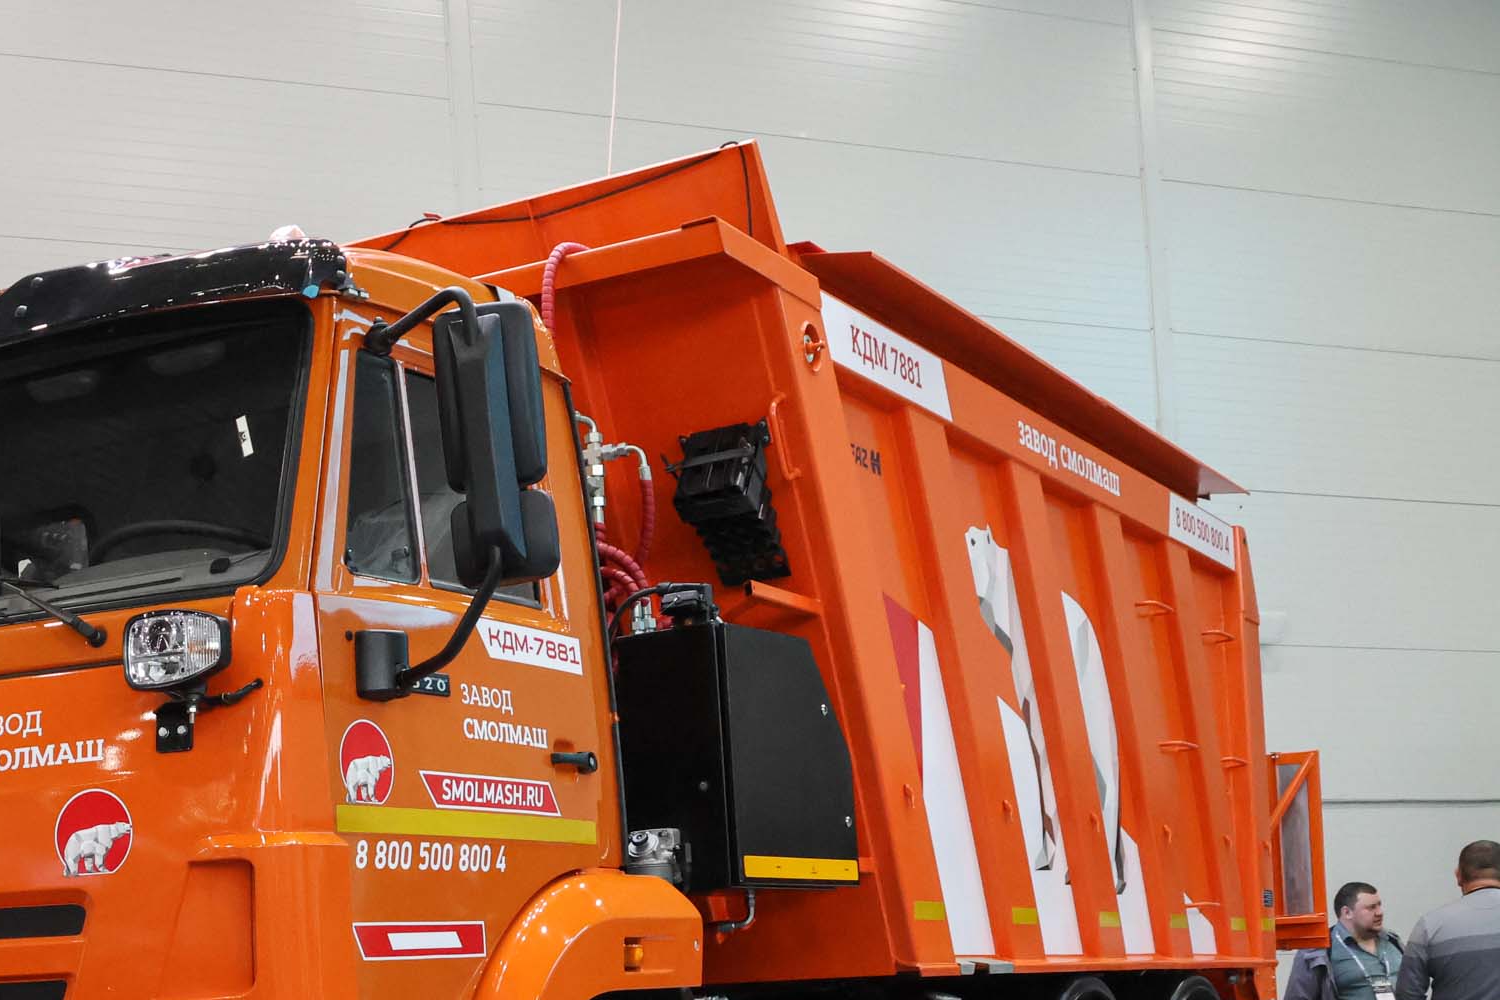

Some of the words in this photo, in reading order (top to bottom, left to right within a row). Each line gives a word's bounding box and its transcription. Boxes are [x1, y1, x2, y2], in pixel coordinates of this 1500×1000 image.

[850, 324, 888, 370] КДМ
[890, 346, 922, 388] 7881
[488, 627, 580, 665] КДМ-7881
[460, 683, 514, 715] ЗАВОД
[463, 718, 548, 749] СМОЛМАШ
[442, 779, 544, 807] SMOLMASH.RU
[355, 840, 368, 869] 8
[374, 840, 412, 870] 800
[418, 841, 453, 871] 500
[459, 843, 492, 872] 800
[496, 845, 507, 873] 4
